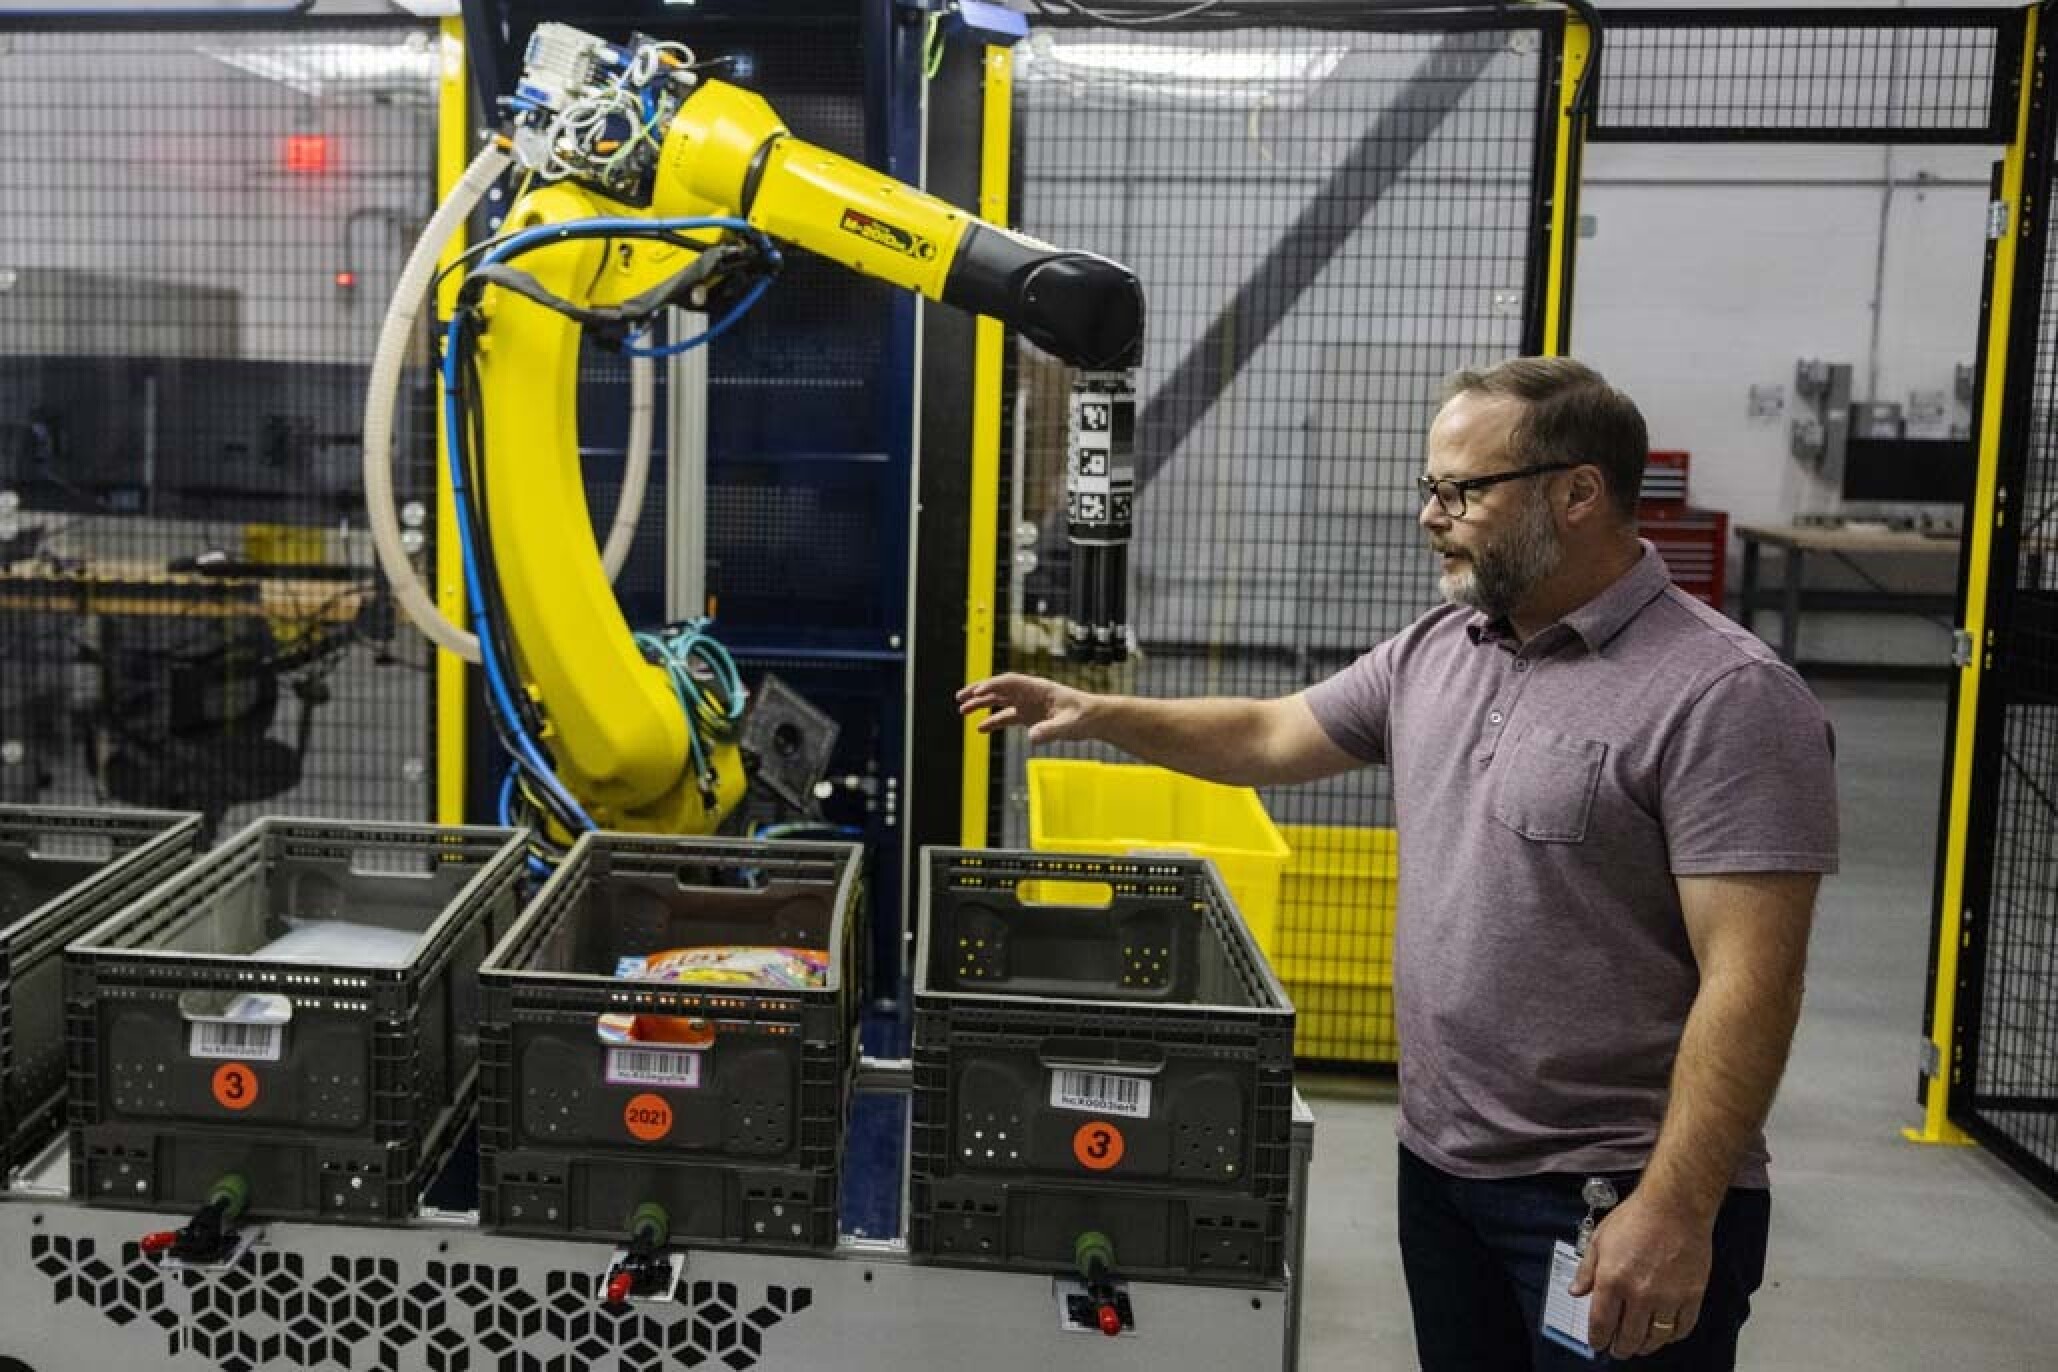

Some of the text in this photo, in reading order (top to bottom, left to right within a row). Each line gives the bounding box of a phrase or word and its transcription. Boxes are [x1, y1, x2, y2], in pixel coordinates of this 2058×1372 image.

[224, 1071, 244, 1099] 3
[629, 1108, 667, 1126] 2021
[1087, 1130, 1111, 1159] 3
